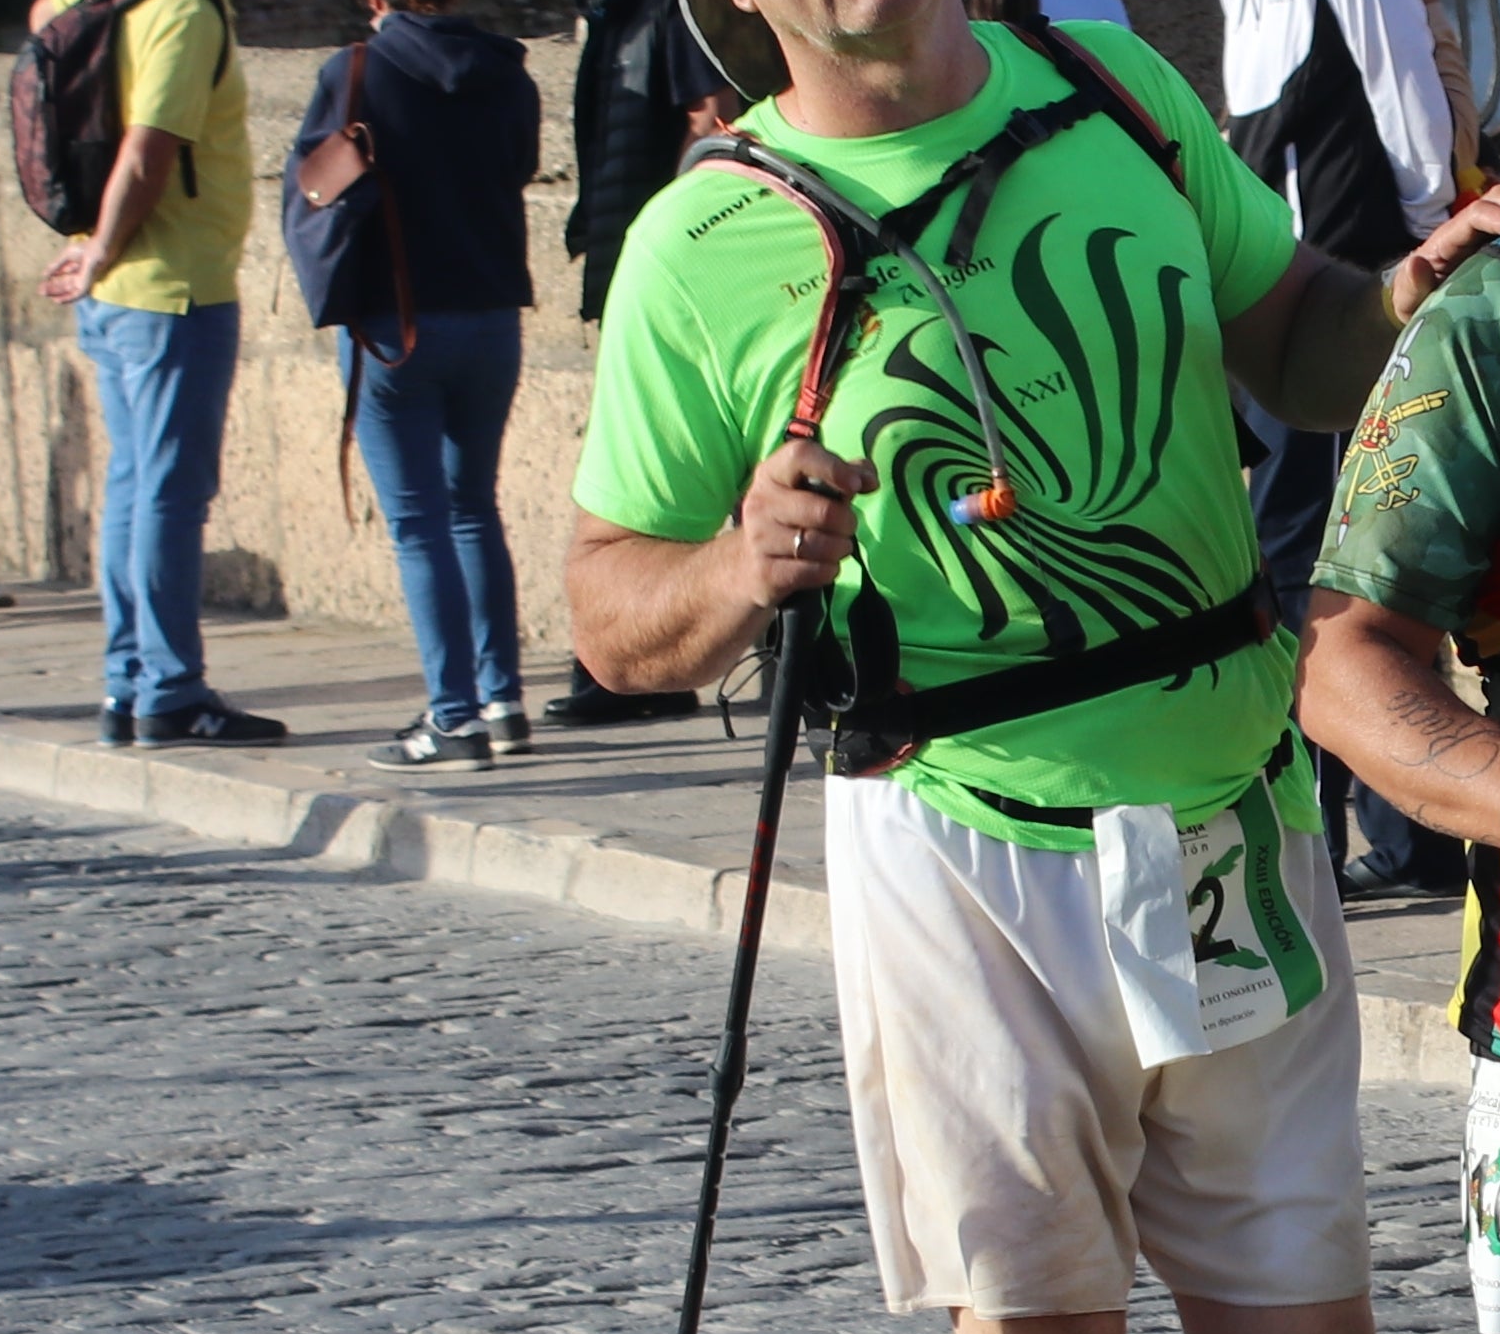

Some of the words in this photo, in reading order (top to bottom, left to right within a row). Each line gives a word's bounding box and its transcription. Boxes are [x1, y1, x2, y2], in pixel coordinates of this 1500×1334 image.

[899, 257, 996, 304] Agon
[1014, 372, 1066, 407] XXI
[1258, 888, 1297, 953] EDICIÓN
